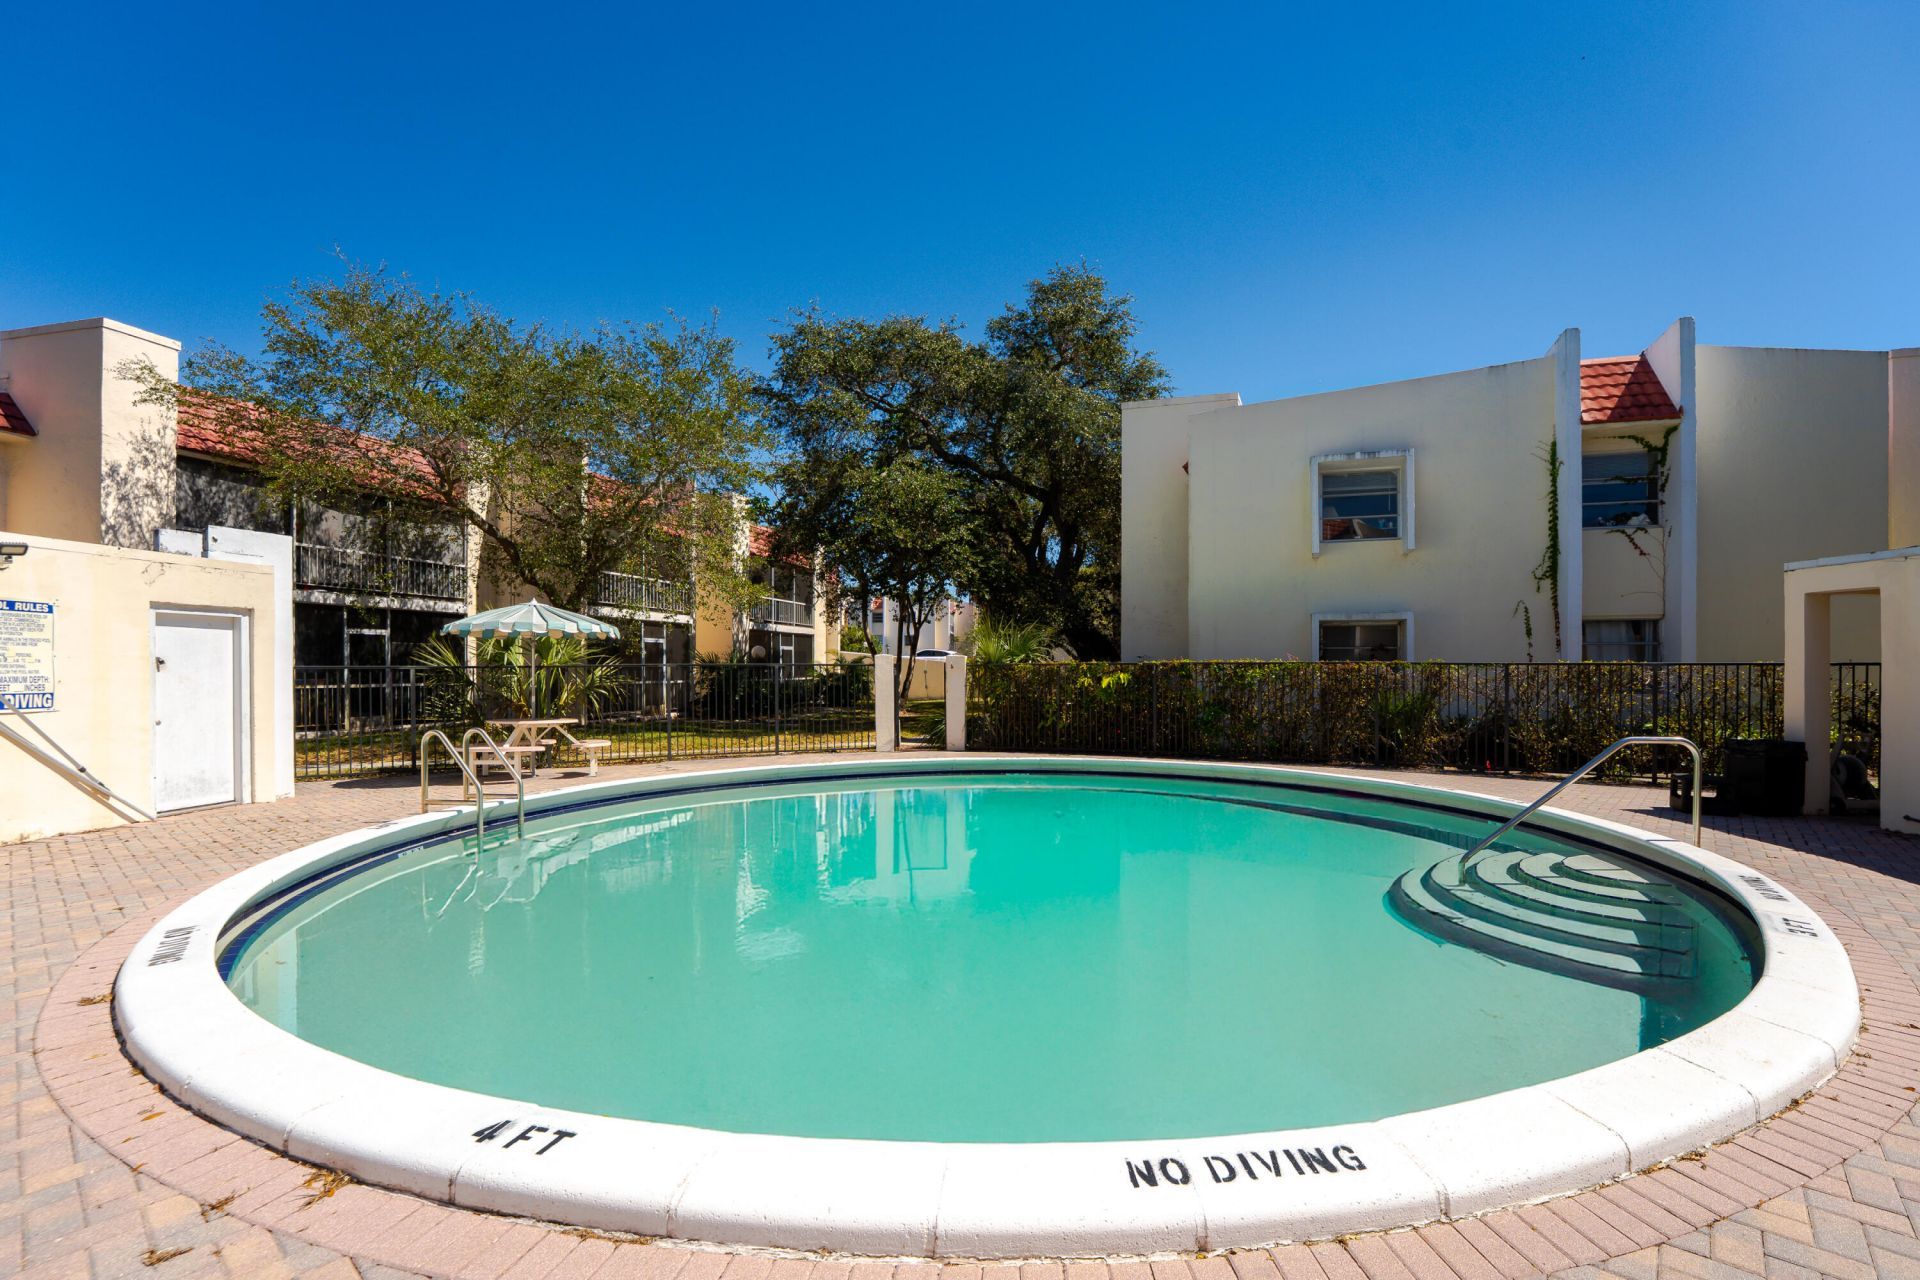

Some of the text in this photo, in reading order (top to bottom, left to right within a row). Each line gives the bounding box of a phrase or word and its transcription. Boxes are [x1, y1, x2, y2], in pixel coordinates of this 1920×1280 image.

[14, 602, 49, 612] RULES
[24, 684, 46, 692] INCHES
[3, 693, 53, 709] DIVING
[1781, 916, 1815, 931] FT
[471, 1119, 578, 1155] 4 FT
[1125, 1145, 1367, 1189] NO DIVING
